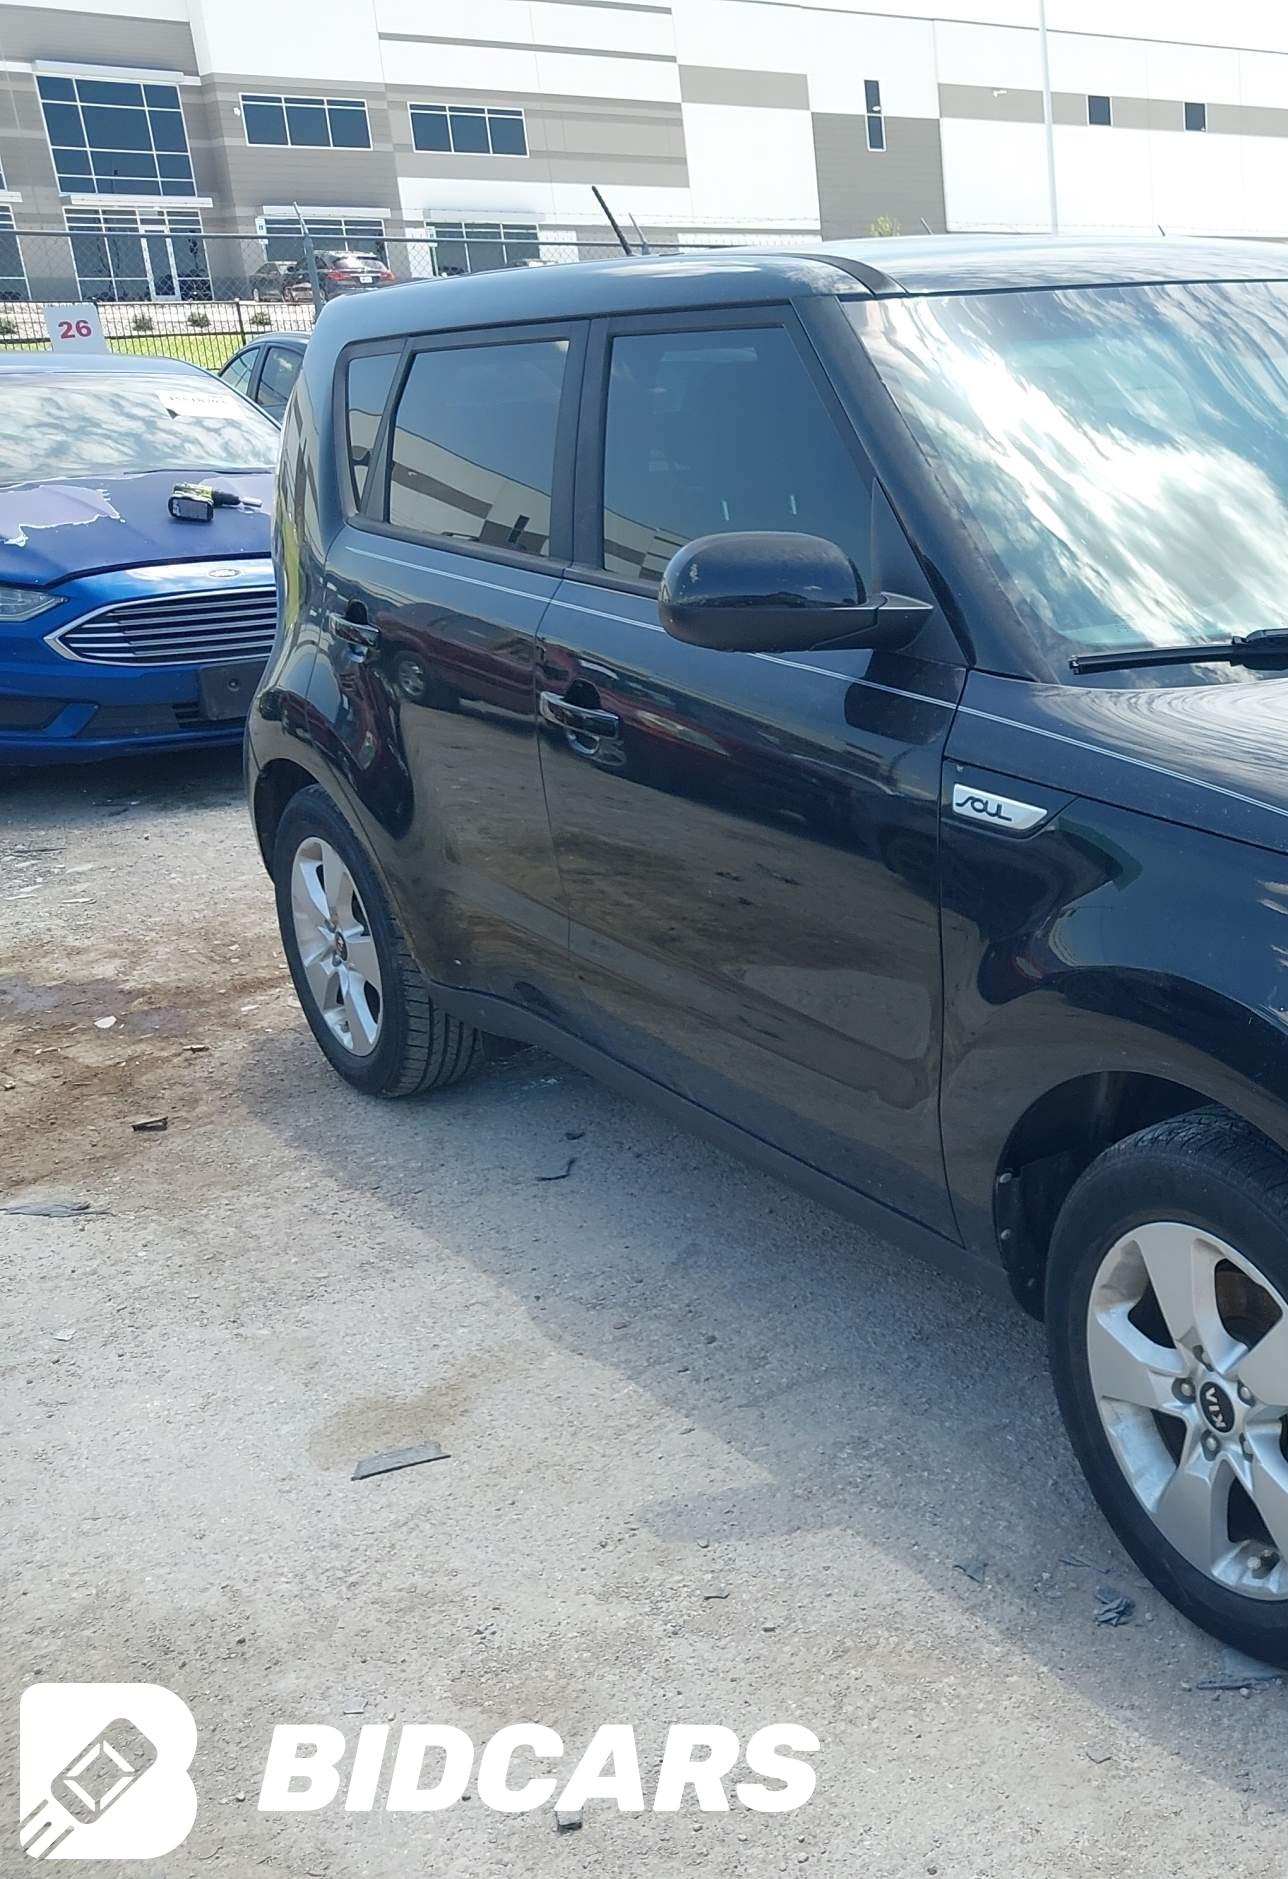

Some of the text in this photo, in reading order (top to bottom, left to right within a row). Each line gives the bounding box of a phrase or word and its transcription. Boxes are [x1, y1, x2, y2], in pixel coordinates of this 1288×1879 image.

[58, 319, 92, 339] 26
[955, 796, 1013, 822] SOUL
[1205, 1387, 1227, 1428] KIA
